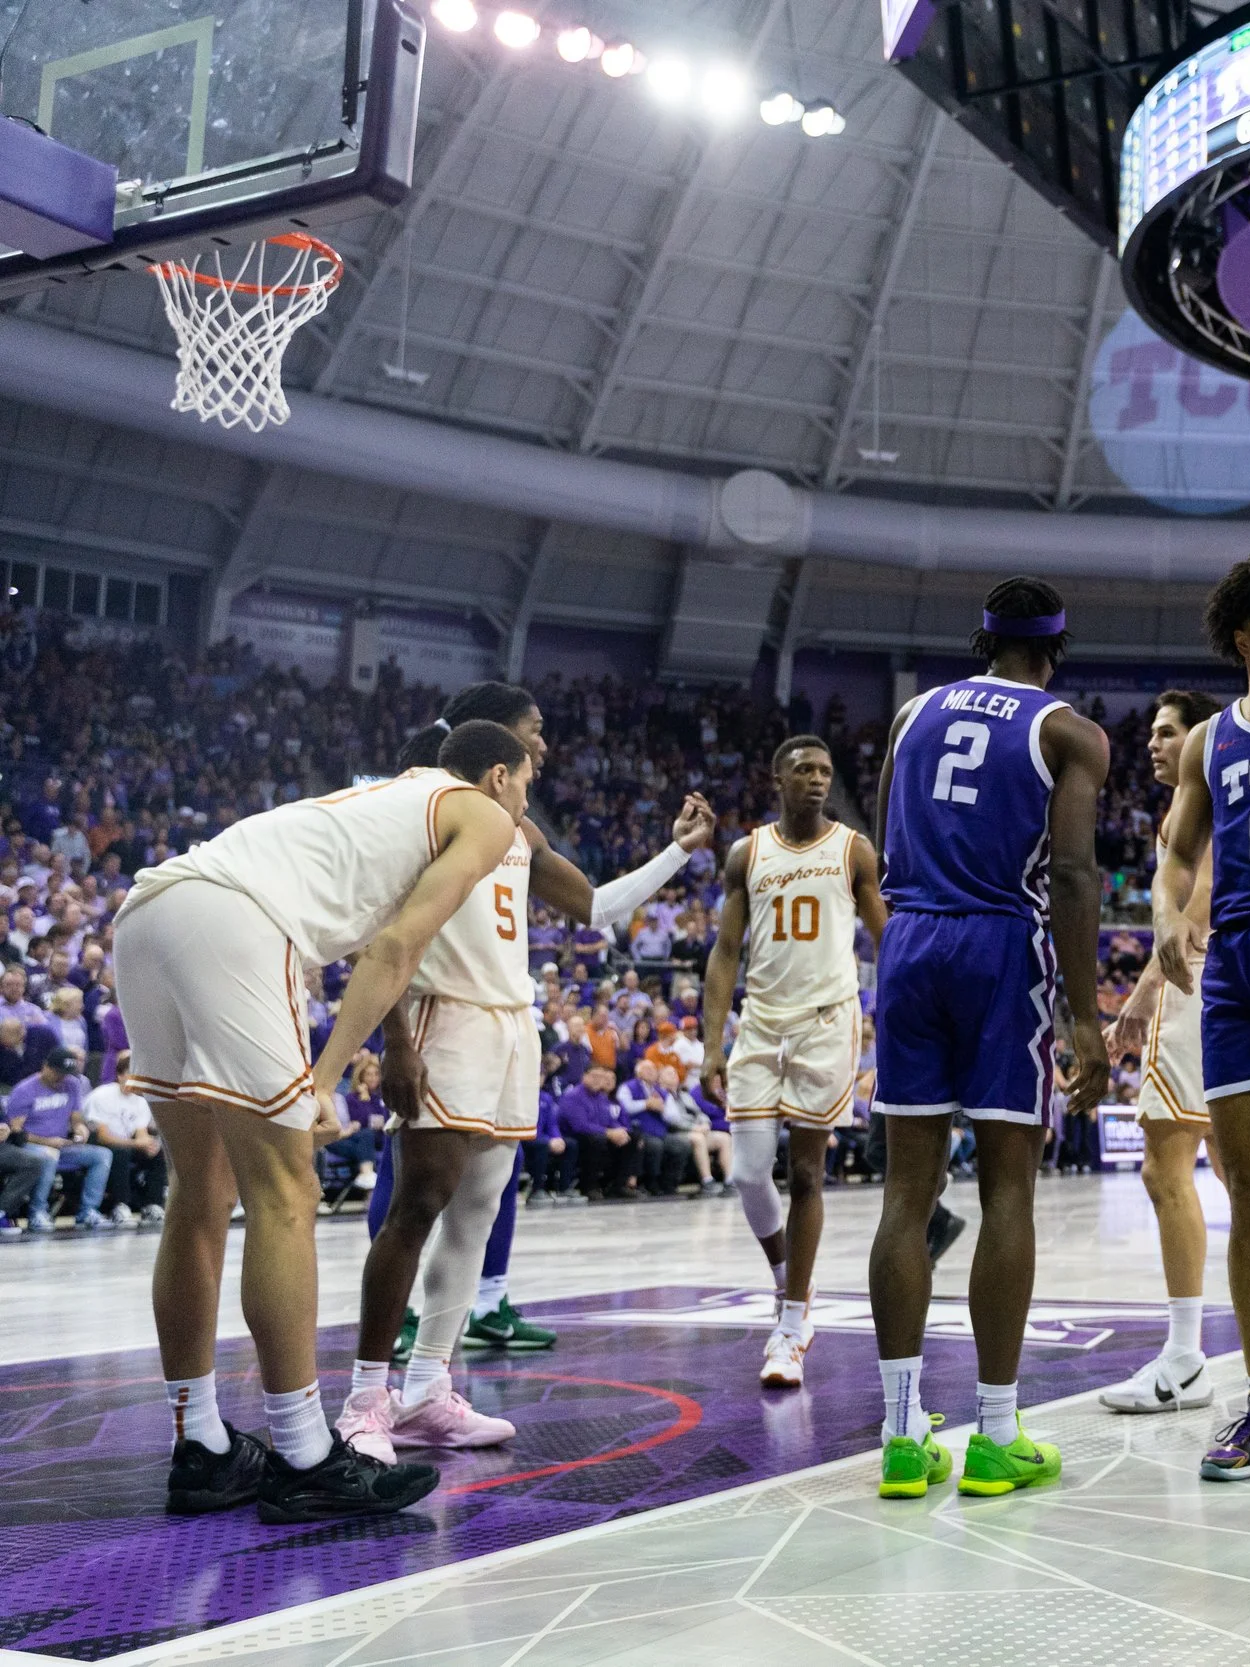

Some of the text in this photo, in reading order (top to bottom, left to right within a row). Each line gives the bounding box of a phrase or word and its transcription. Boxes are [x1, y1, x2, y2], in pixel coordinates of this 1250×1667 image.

[940, 689, 1021, 720] MILLER
[932, 720, 991, 805] 2
[755, 866, 842, 895] Longhorns
[494, 883, 517, 941] 5
[772, 895, 820, 941] 10
